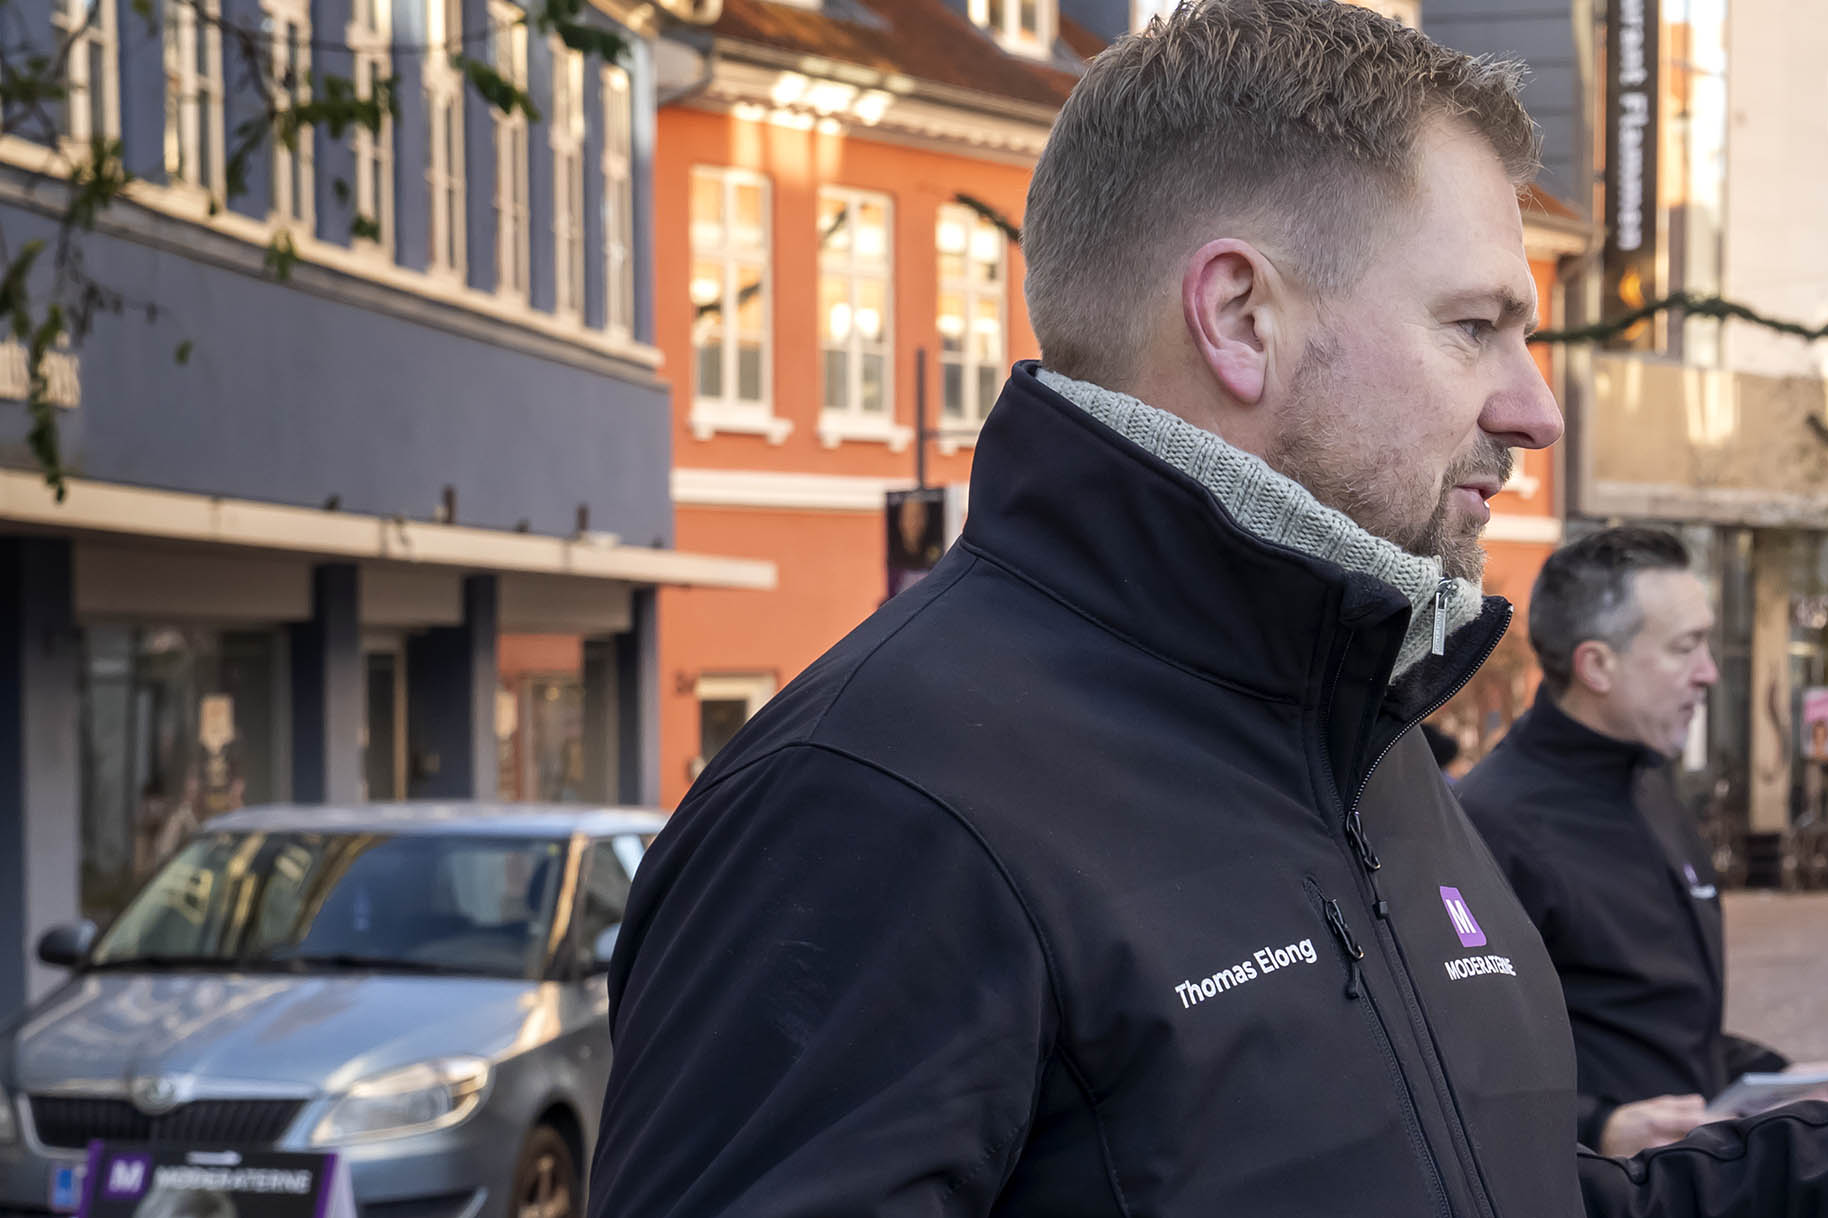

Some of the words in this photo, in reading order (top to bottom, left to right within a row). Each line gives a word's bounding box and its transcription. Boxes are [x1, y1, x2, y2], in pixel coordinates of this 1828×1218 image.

[1445, 899, 1476, 934] M
[1175, 959, 1258, 1009] Thomas
[1253, 938, 1317, 974] Elong
[1444, 955, 1517, 981] MODERATERNE
[108, 1159, 146, 1192] M
